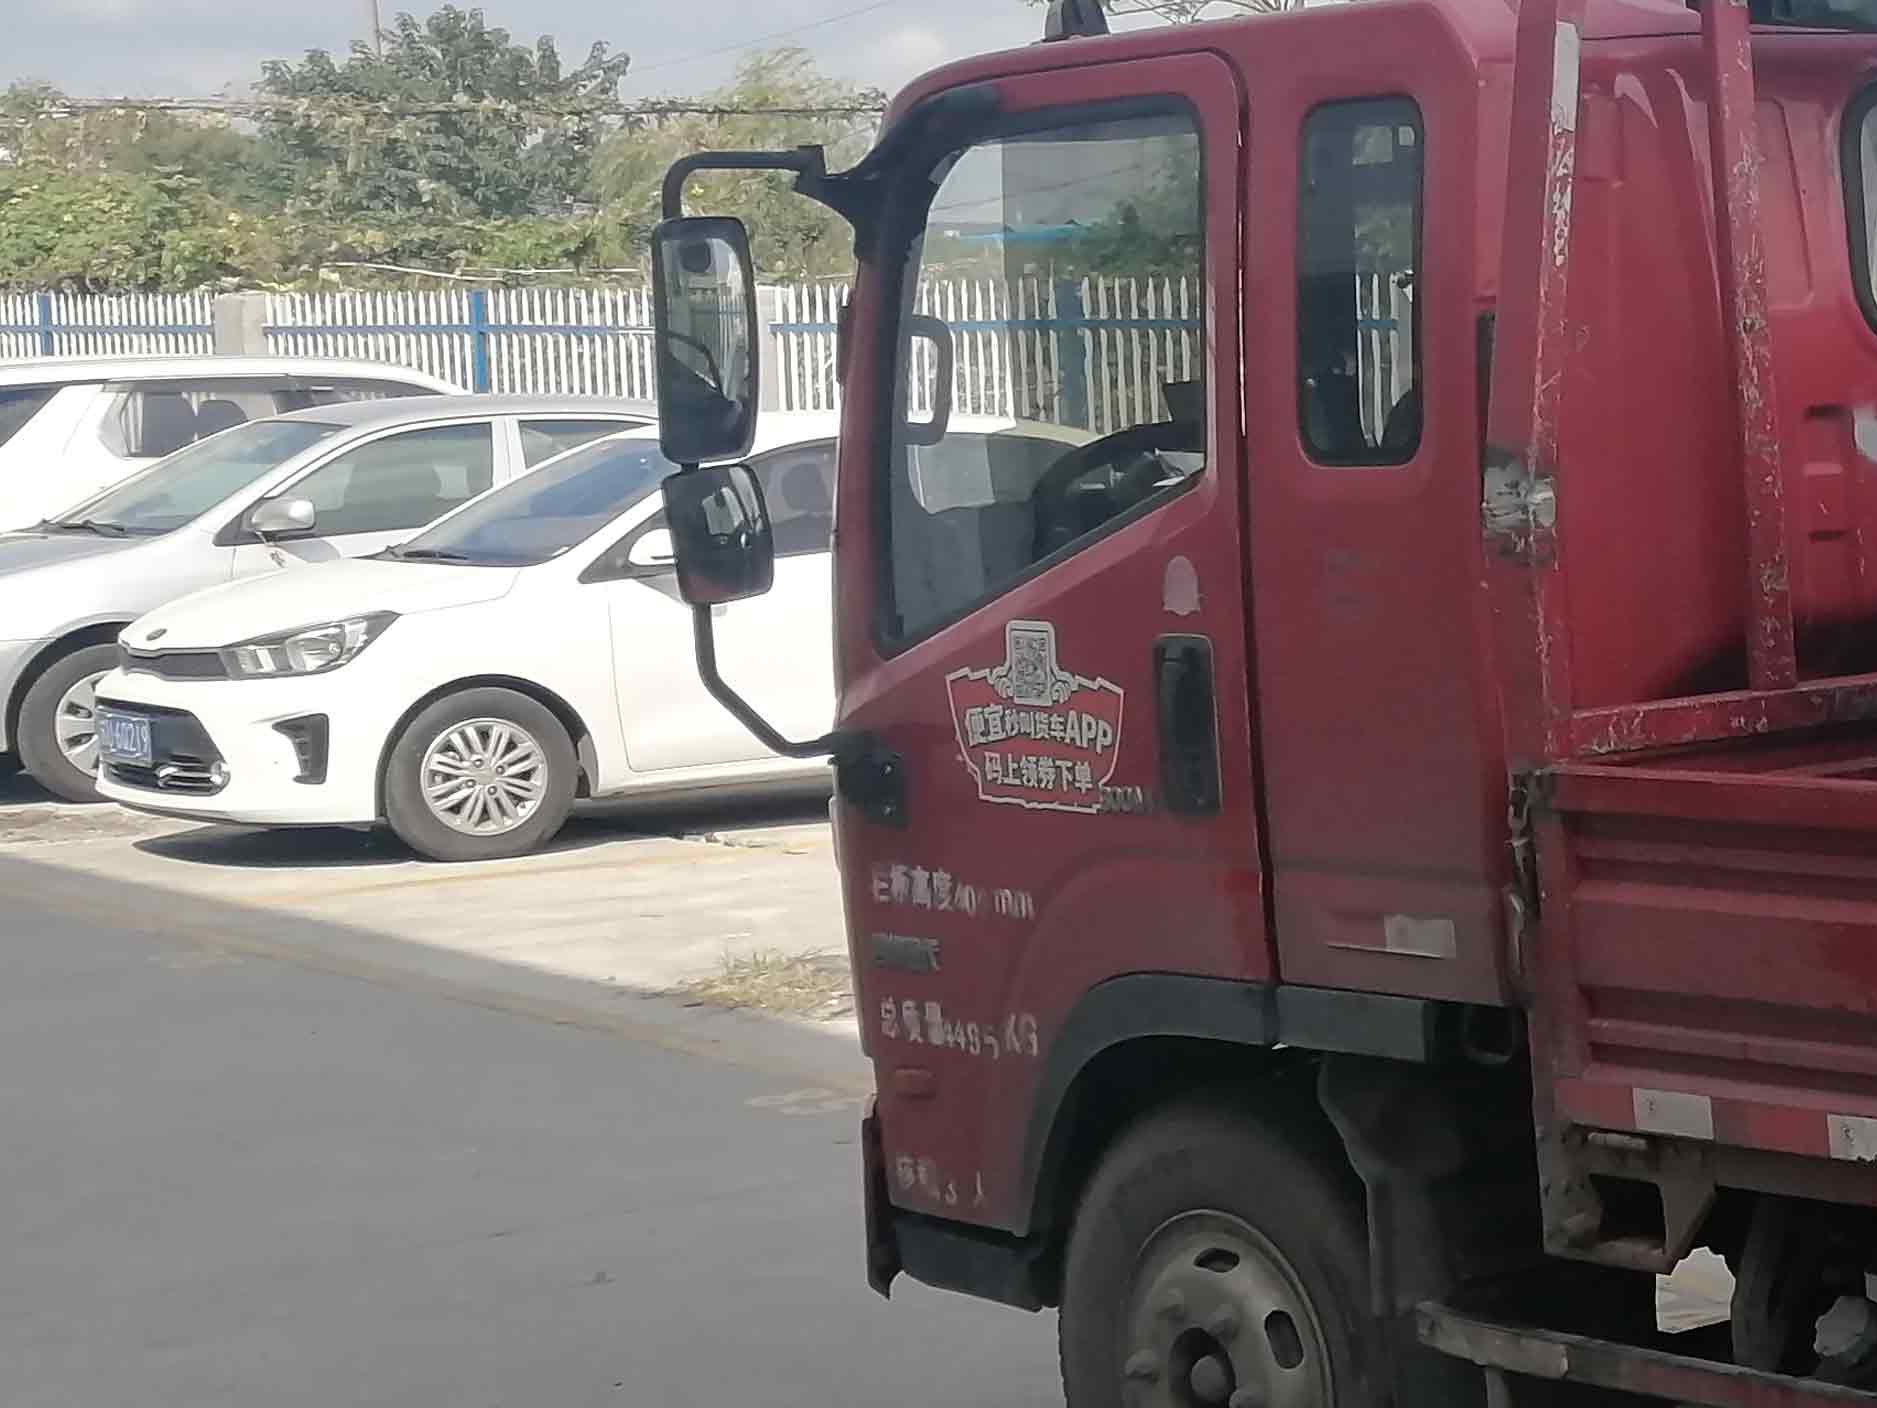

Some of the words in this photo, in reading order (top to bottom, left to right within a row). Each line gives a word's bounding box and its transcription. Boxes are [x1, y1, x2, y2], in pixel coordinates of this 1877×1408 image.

[965, 703, 1114, 755] 便宜秒叫货车APP
[983, 750, 1095, 794] 码上领券下单
